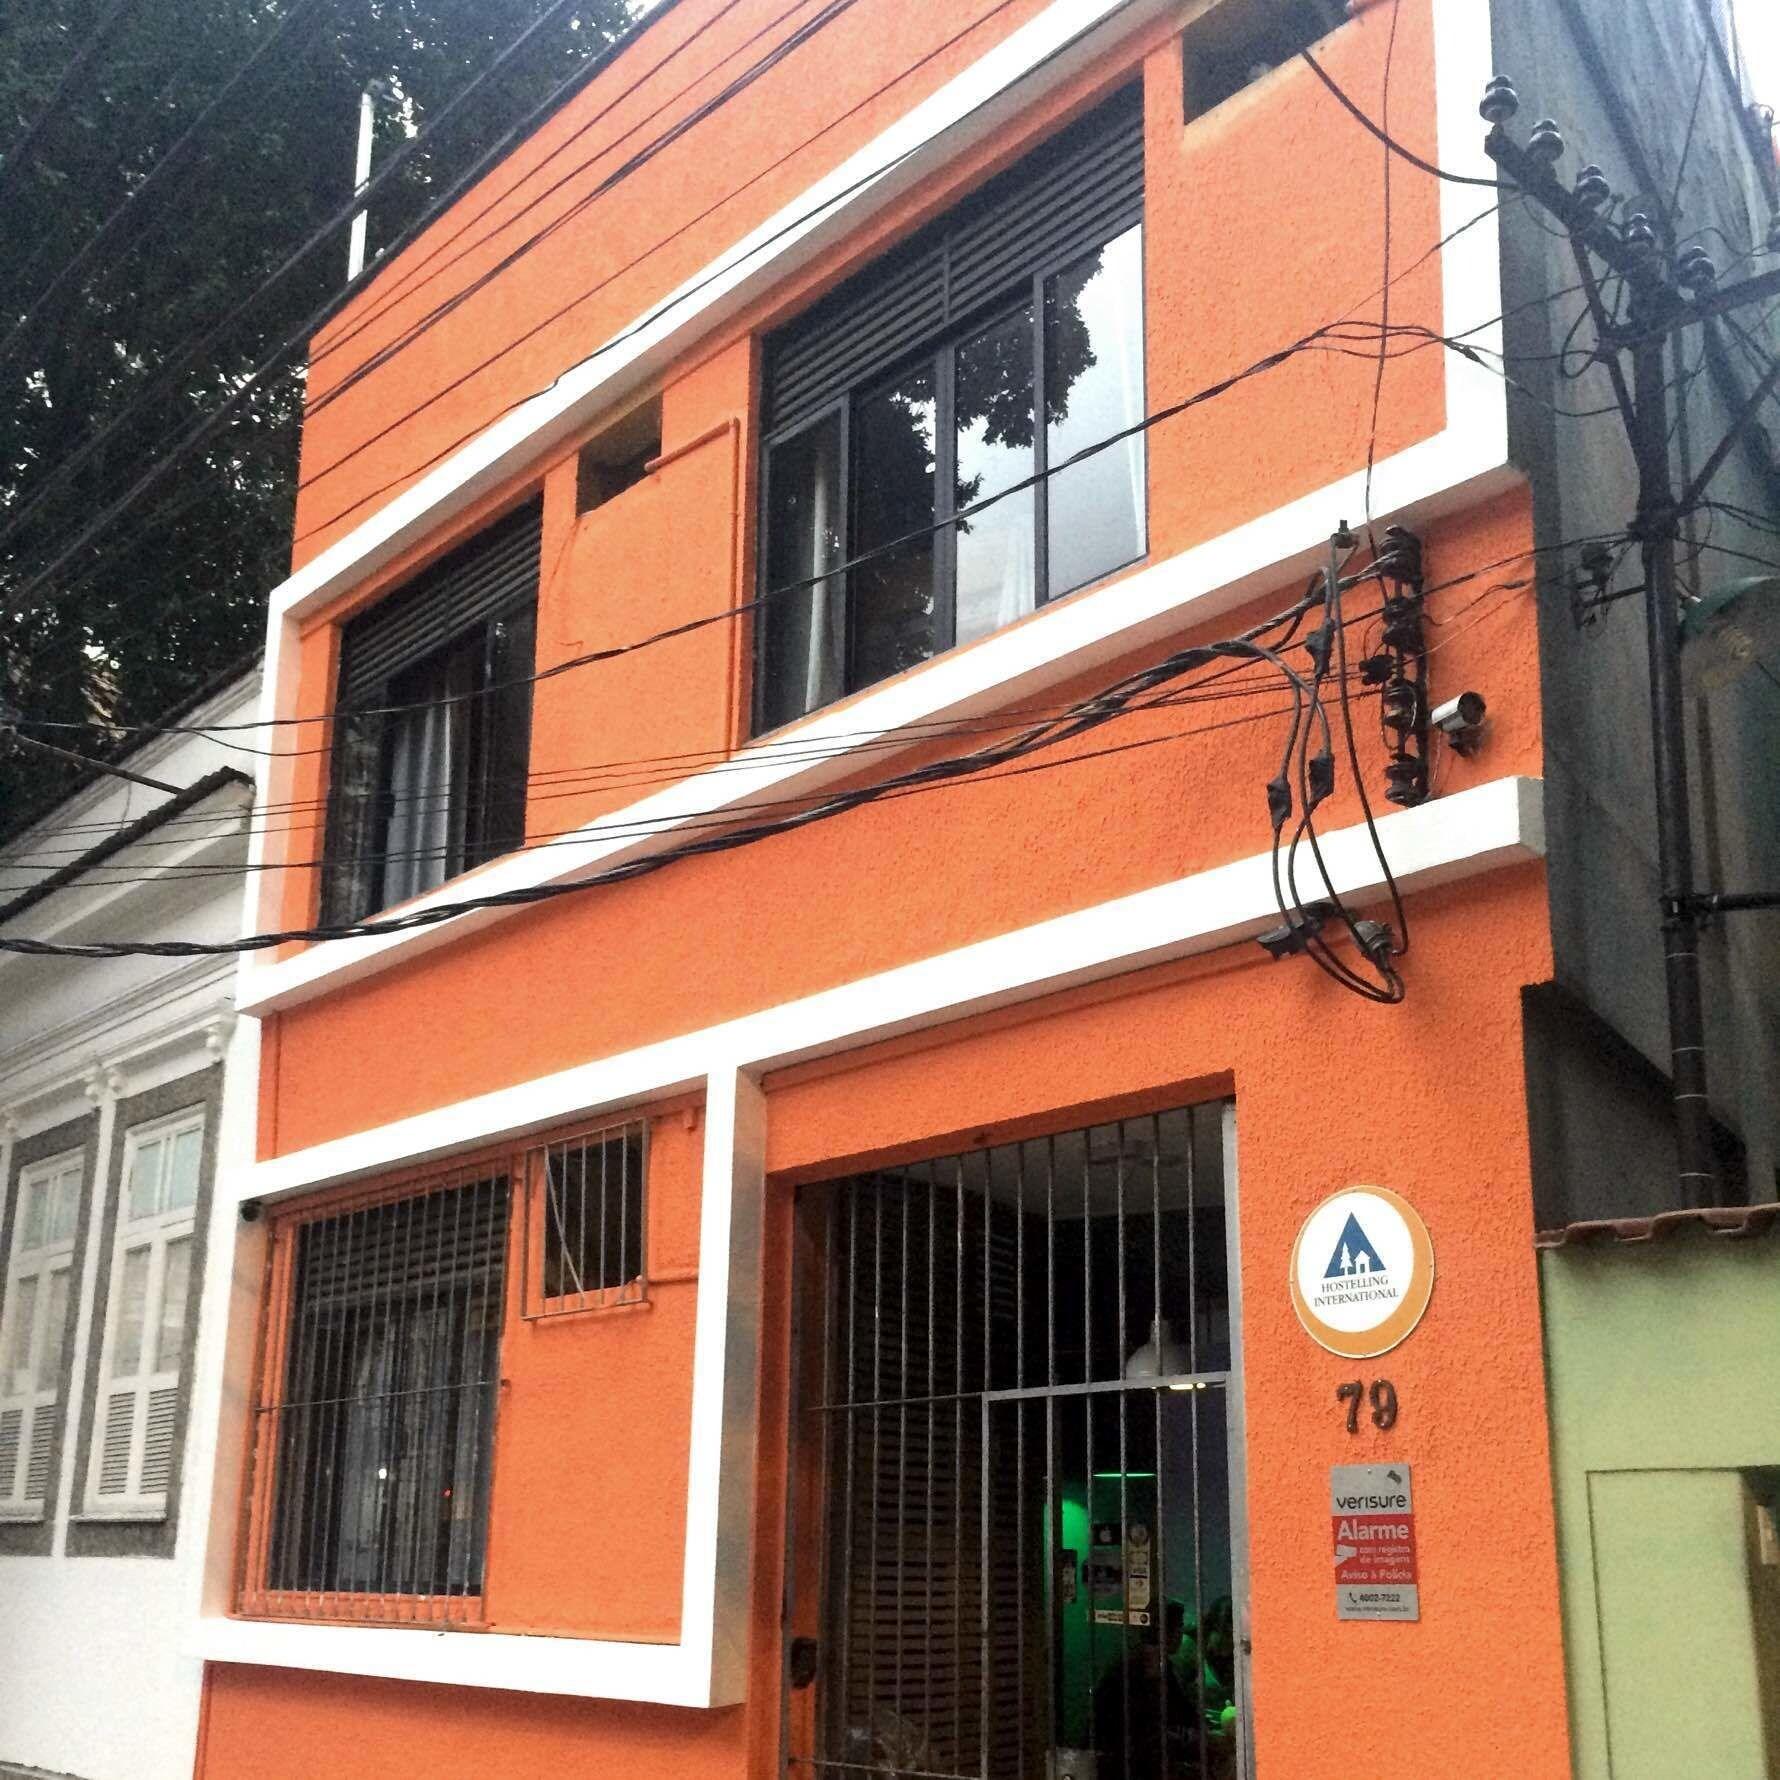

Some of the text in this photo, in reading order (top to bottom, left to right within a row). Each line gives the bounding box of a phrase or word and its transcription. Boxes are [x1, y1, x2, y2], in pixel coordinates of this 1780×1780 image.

[1321, 1275, 1389, 1293] HOSTELLING
[1314, 1287, 1399, 1307] INTERNATIONAL
[1336, 1379, 1398, 1434] 79
[1336, 1494, 1407, 1509] verisure
[1337, 1519, 1409, 1540] Alarme
